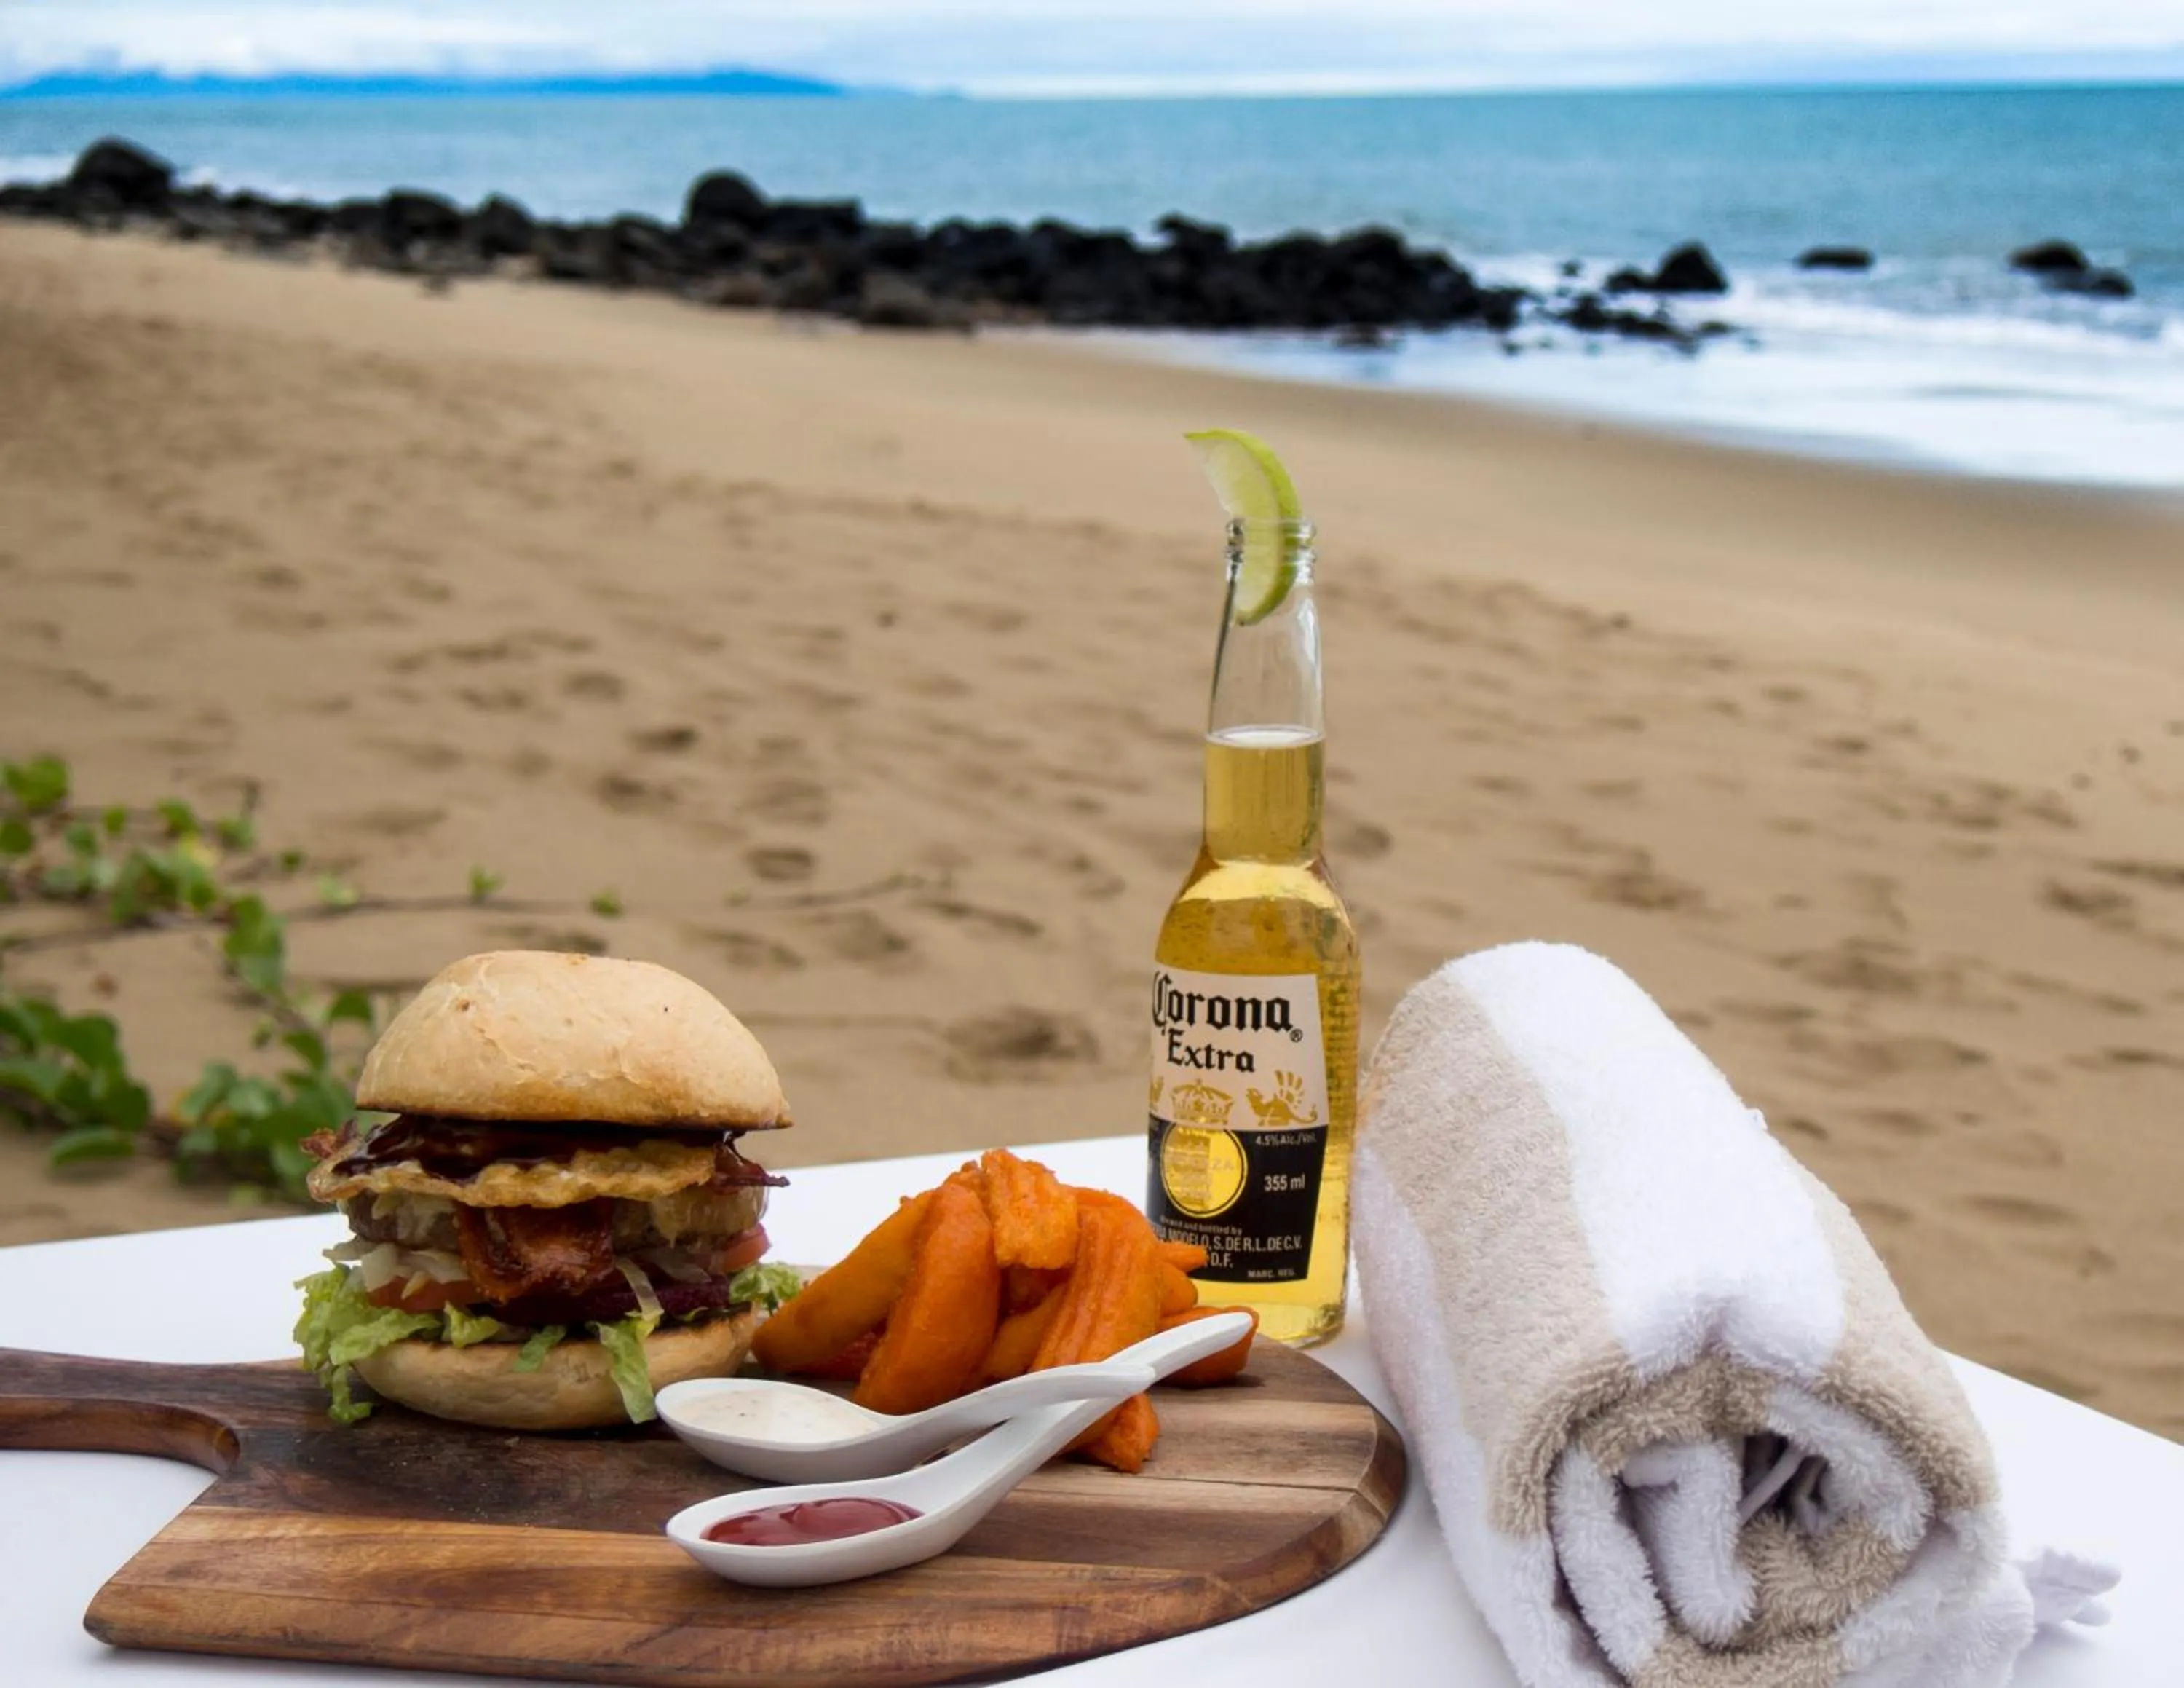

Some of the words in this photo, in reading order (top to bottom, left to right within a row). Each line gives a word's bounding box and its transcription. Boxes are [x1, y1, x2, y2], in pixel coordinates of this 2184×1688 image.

[1152, 971, 1293, 1031] Corona
[1162, 1028, 1255, 1072] Extra
[1264, 1175, 1288, 1191] 355
[1290, 1172, 1305, 1190] ml
